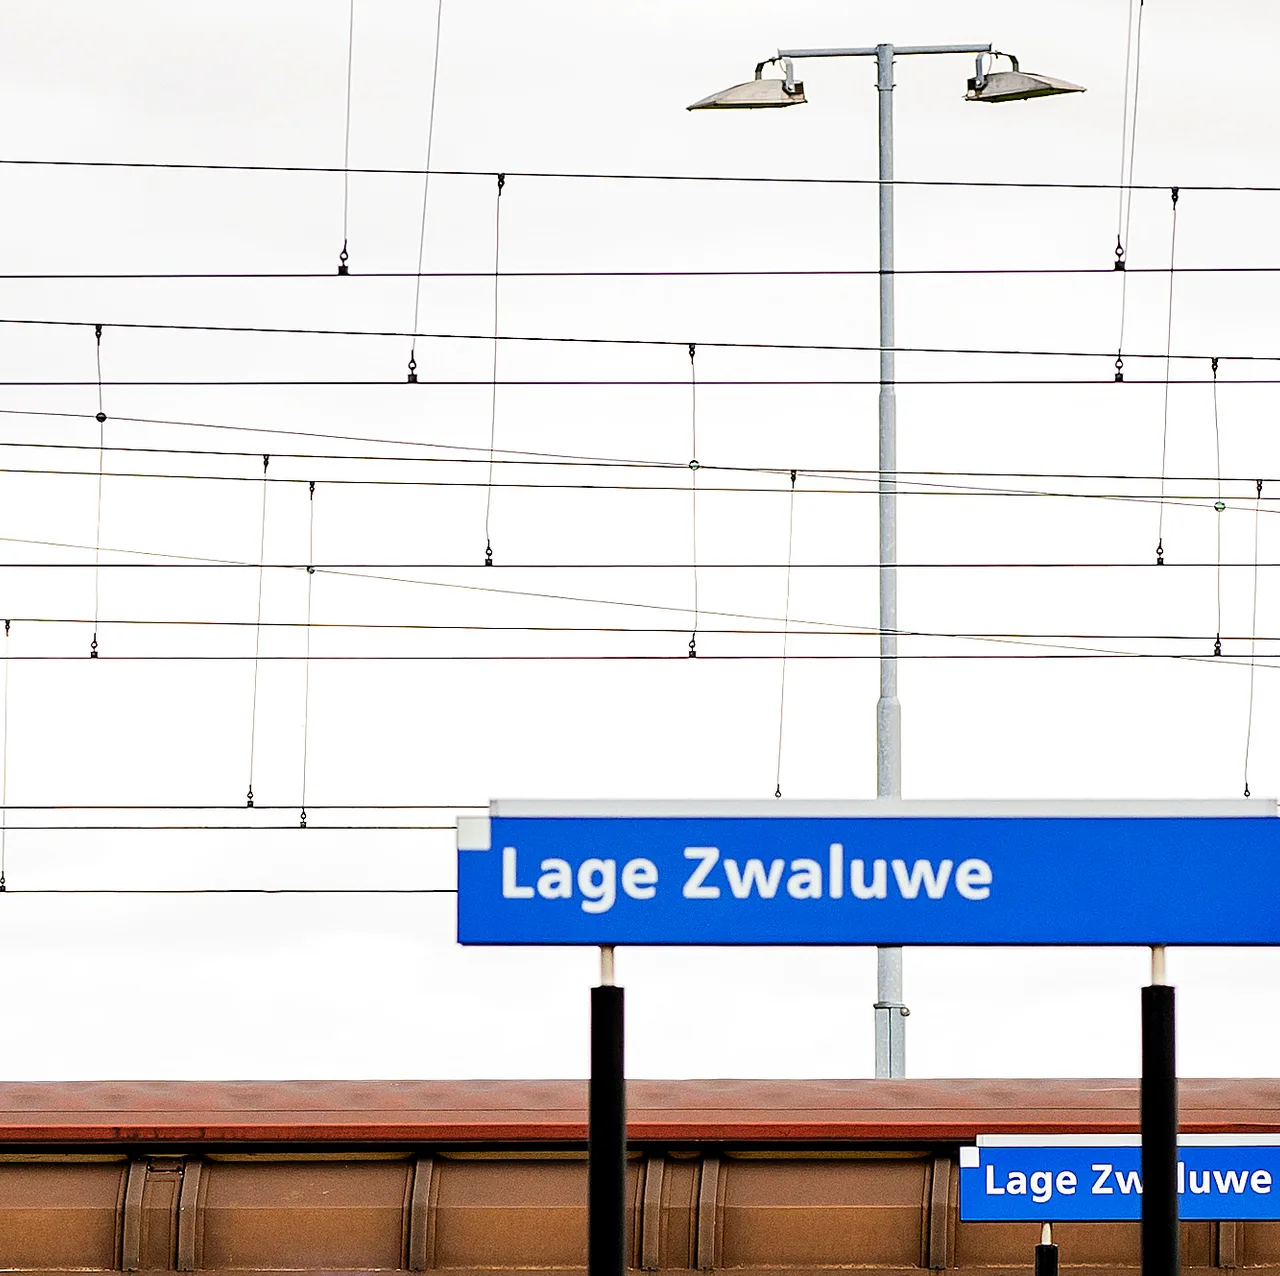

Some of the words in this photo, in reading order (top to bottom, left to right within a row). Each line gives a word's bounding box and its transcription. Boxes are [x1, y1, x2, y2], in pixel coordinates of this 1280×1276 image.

[501, 844, 658, 915] Lage
[682, 843, 994, 901] Zwaluwe
[985, 1163, 1077, 1203] Lage
[1091, 1162, 1273, 1196] Zwluwe
